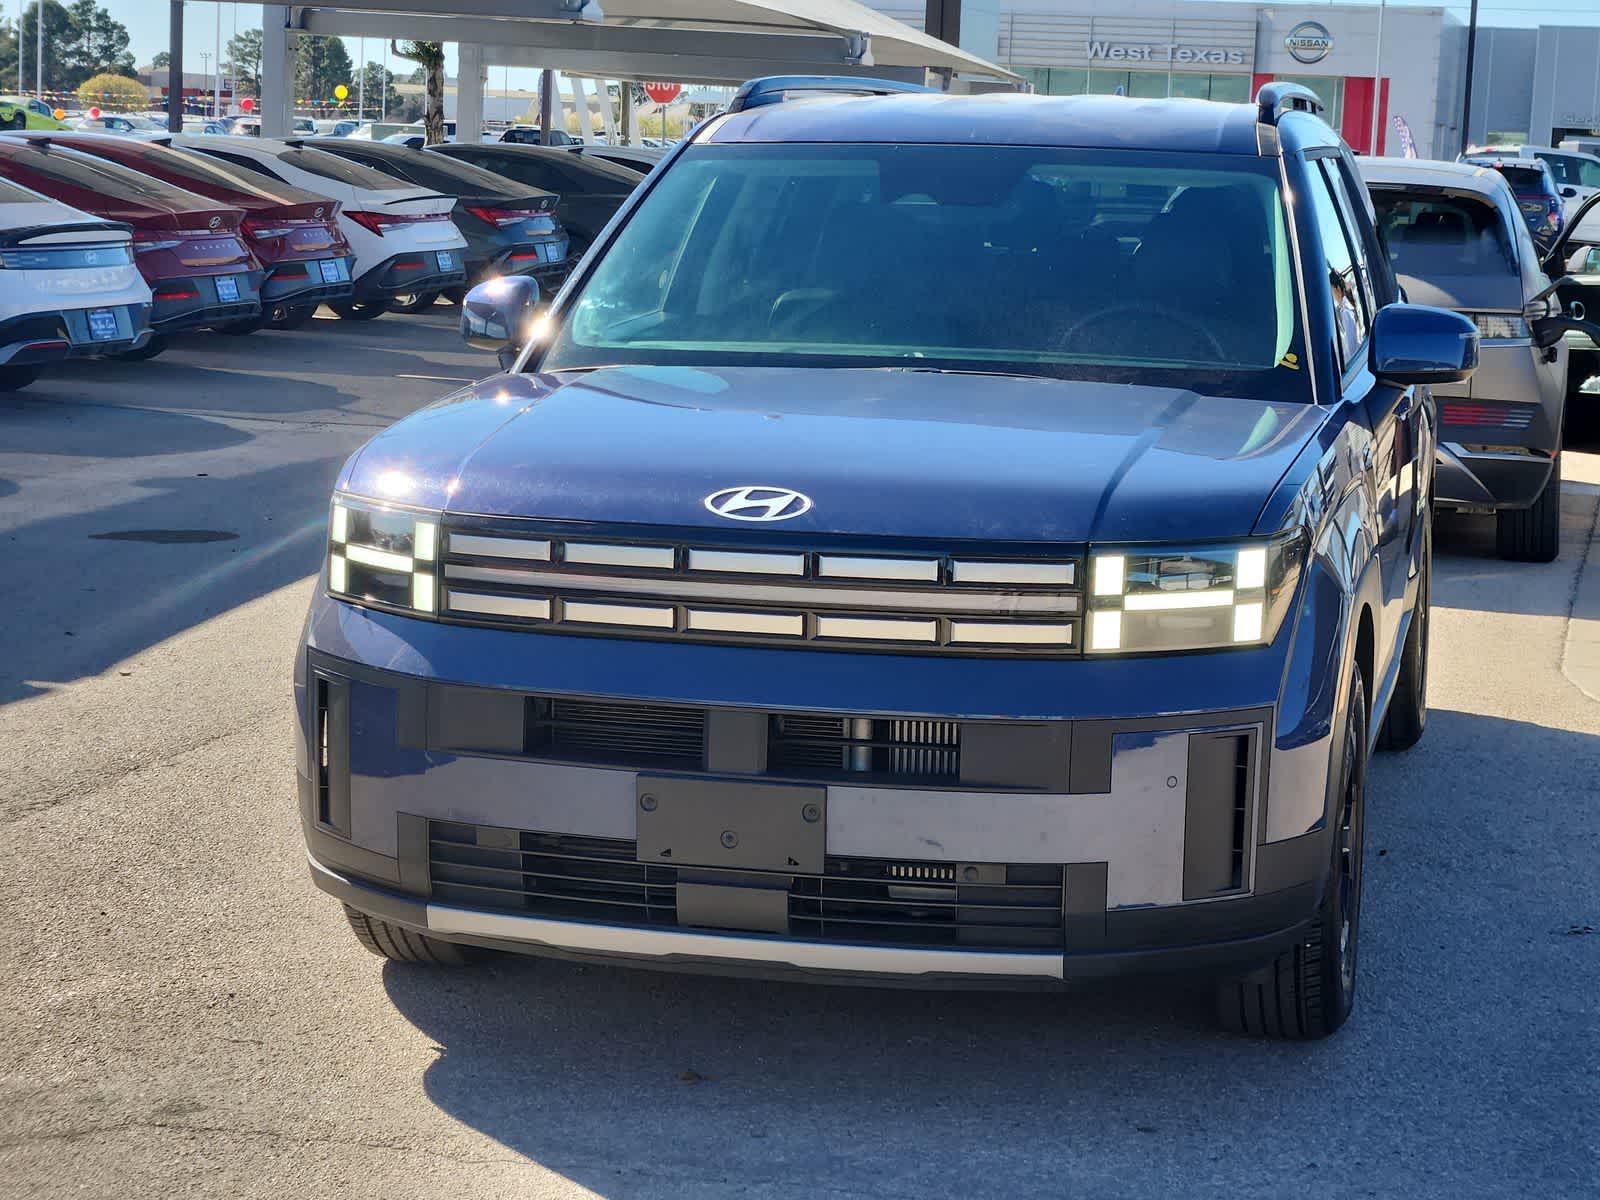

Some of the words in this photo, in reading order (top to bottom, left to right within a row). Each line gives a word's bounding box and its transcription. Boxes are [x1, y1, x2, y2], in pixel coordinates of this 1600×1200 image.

[1290, 39, 1329, 47] NISSAN
[1087, 41, 1152, 61] West
[1162, 43, 1244, 65] Texas
